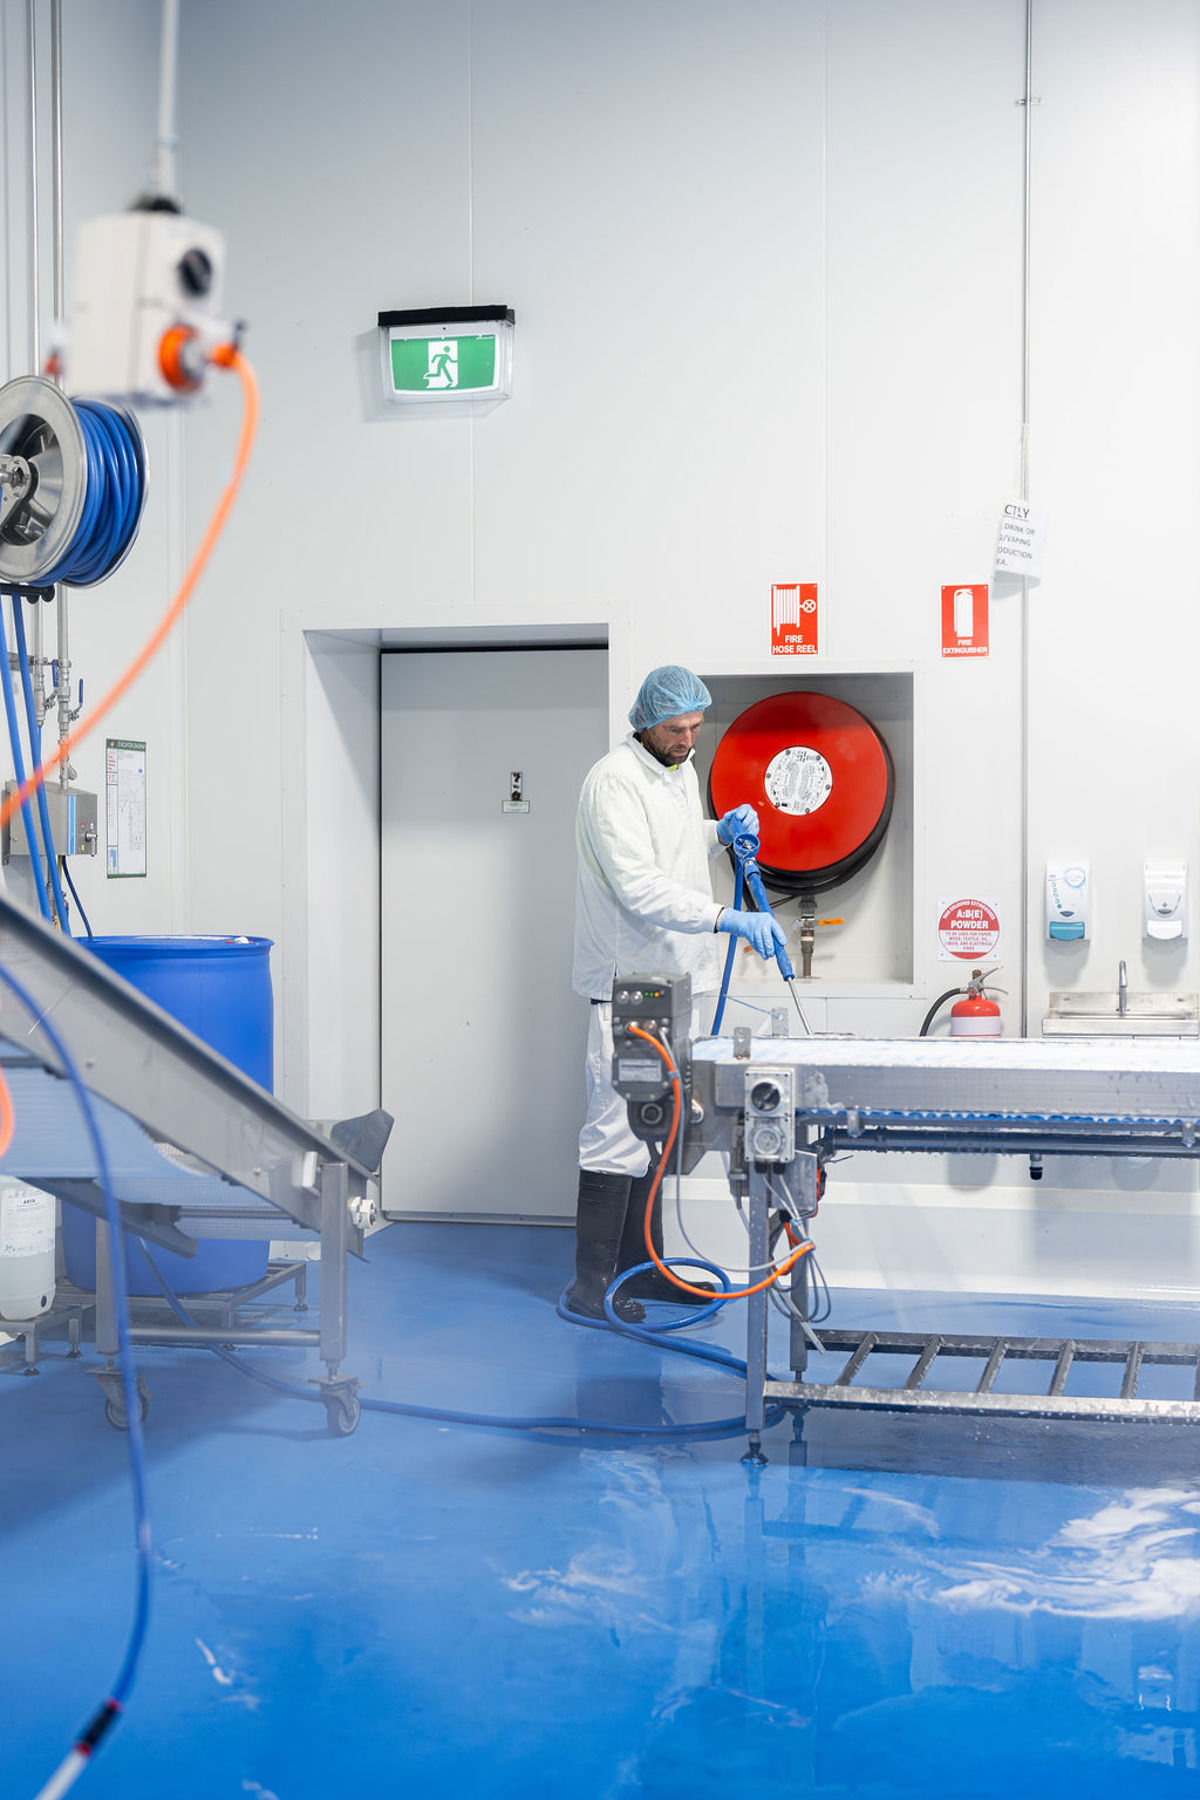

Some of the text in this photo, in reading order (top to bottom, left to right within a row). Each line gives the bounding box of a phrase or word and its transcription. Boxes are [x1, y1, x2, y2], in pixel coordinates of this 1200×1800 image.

[785, 635, 803, 643] FIRE
[772, 645, 817, 653] HOSE REEL
[951, 920, 989, 929] POWDER
